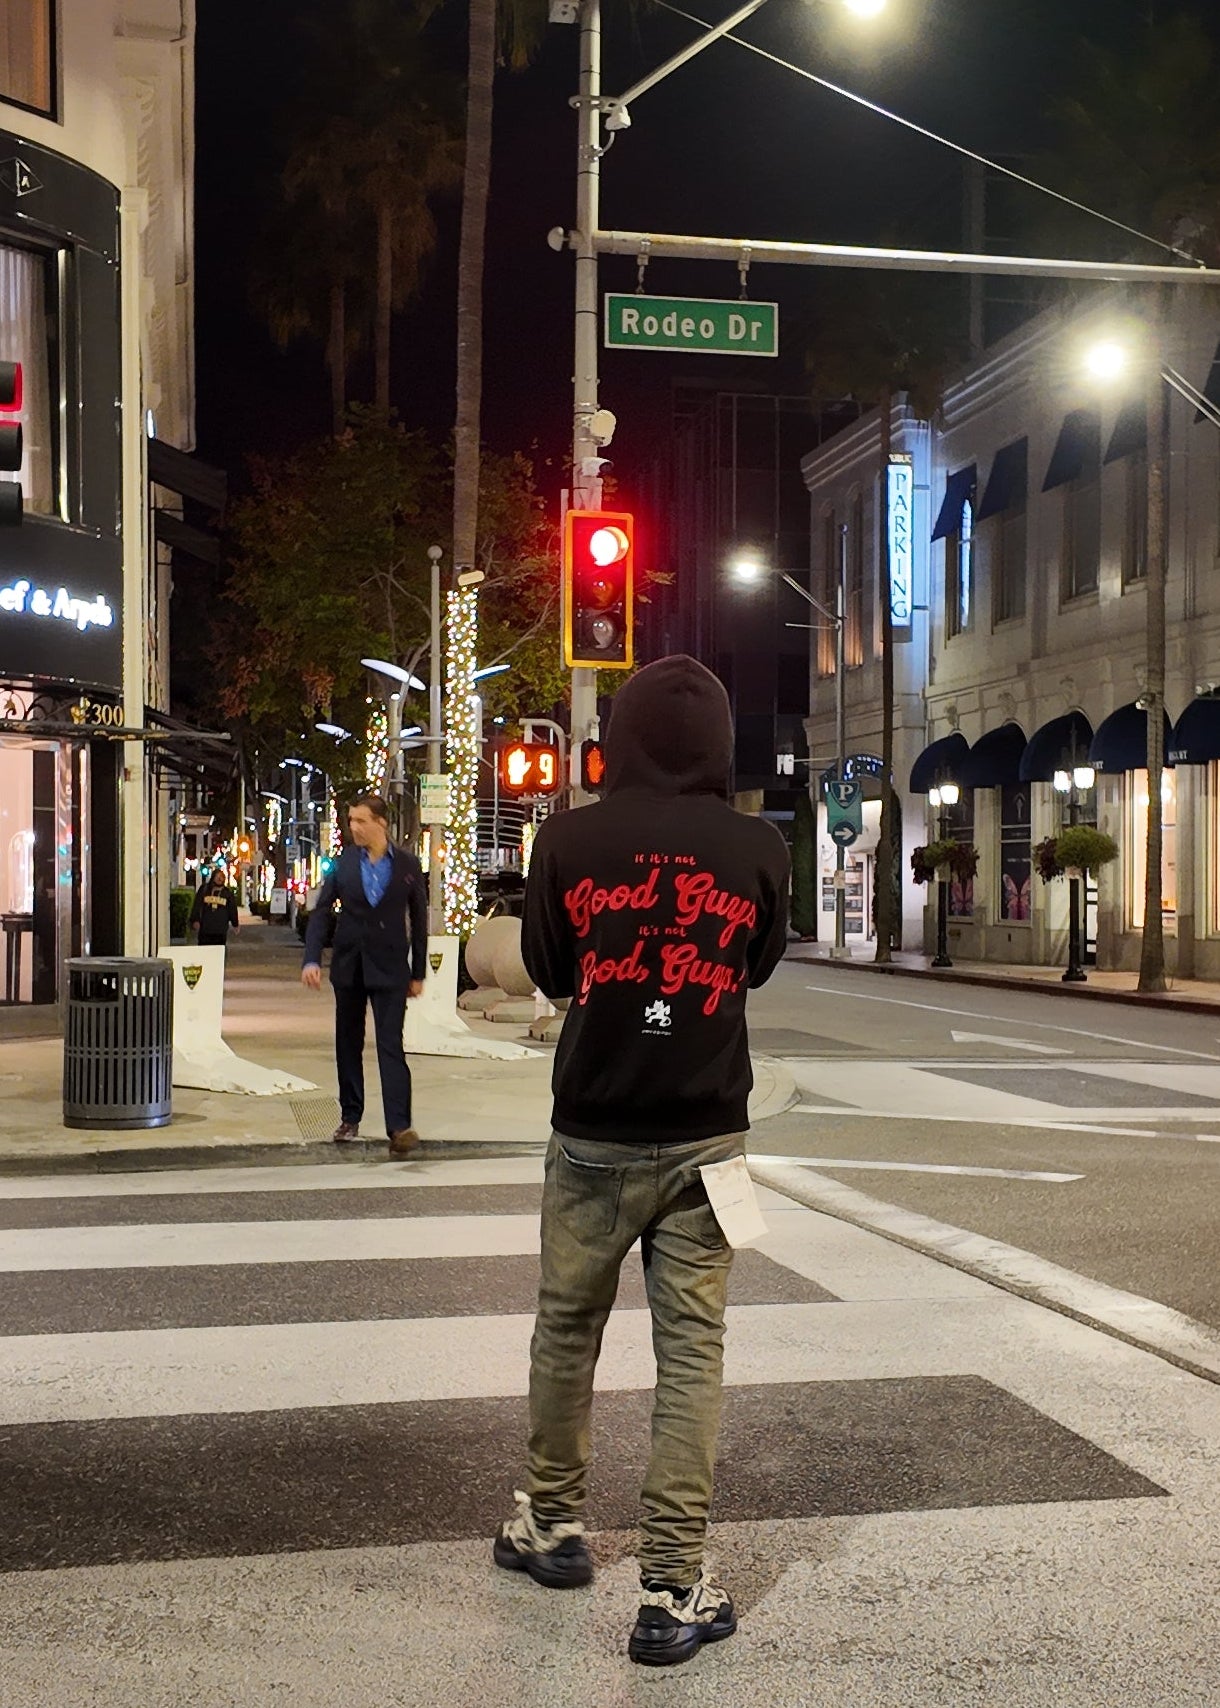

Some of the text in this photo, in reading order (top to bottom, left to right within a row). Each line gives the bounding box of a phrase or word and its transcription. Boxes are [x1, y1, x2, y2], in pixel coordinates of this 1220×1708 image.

[621, 308, 763, 342] Rodeo Dr
[892, 472, 908, 618] PARKING
[91, 703, 124, 728] 300
[538, 752, 555, 786] 9
[838, 784, 854, 802] P
[674, 855, 697, 867] not
[564, 868, 660, 938] Good
[674, 872, 757, 949] Guys
[664, 926, 688, 938] not
